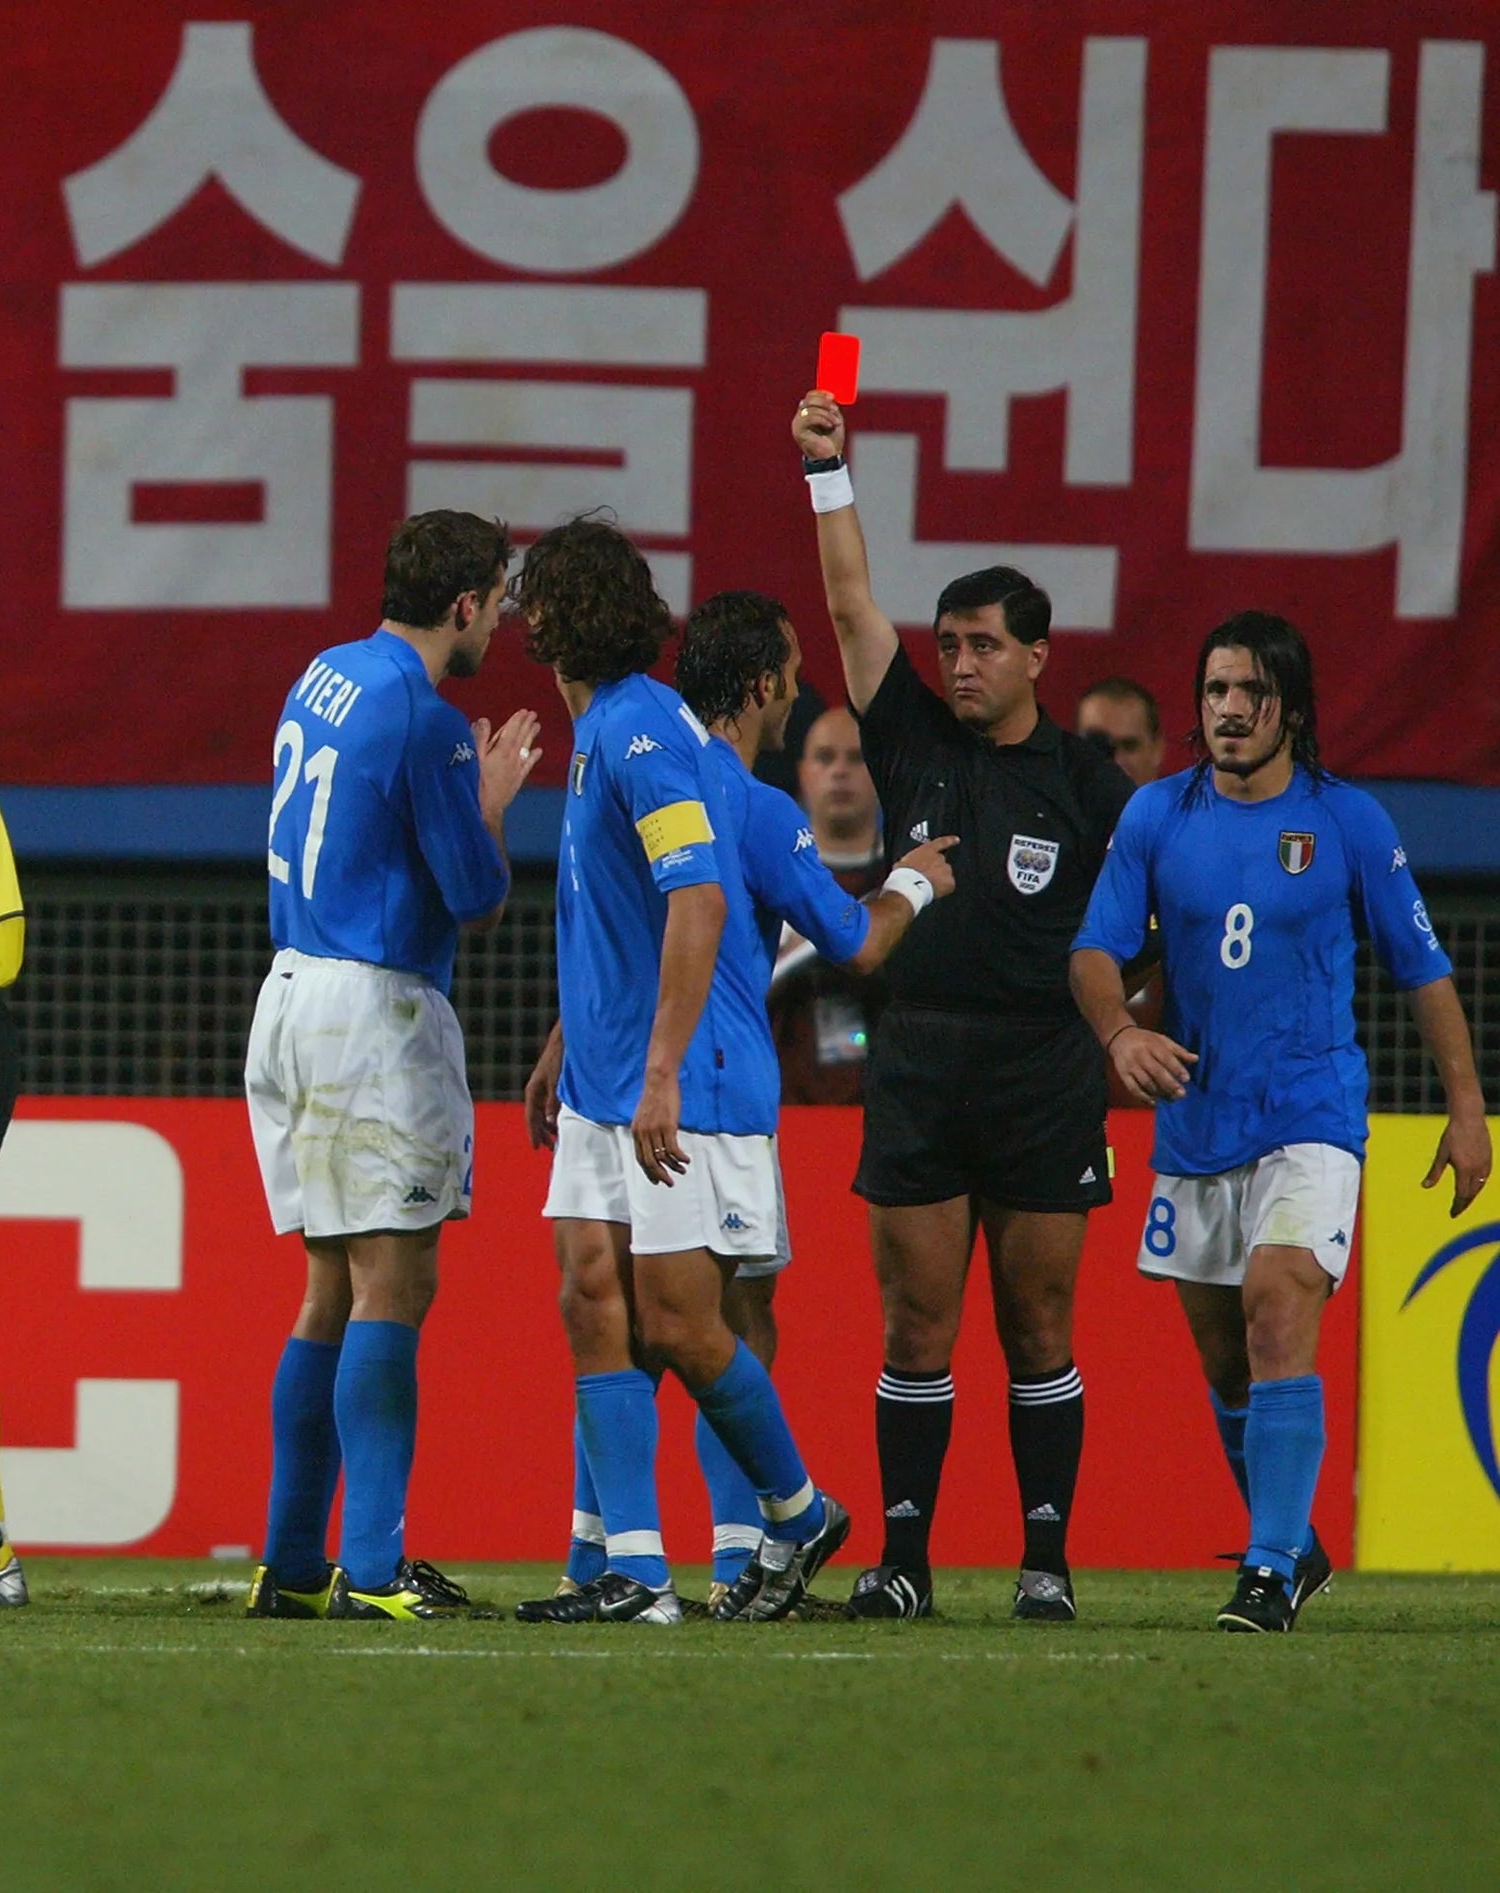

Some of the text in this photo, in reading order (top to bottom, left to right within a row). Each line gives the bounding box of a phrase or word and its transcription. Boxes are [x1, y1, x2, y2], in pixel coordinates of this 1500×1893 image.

[57, 20, 708, 611] 숨을
[834, 36, 1498, 631] 쉰다
[295, 658, 362, 728] VIERI
[268, 720, 339, 900] 21
[1016, 870, 1041, 884] FIFA
[1220, 902, 1255, 970] 8
[1143, 1195, 1177, 1258] 8
